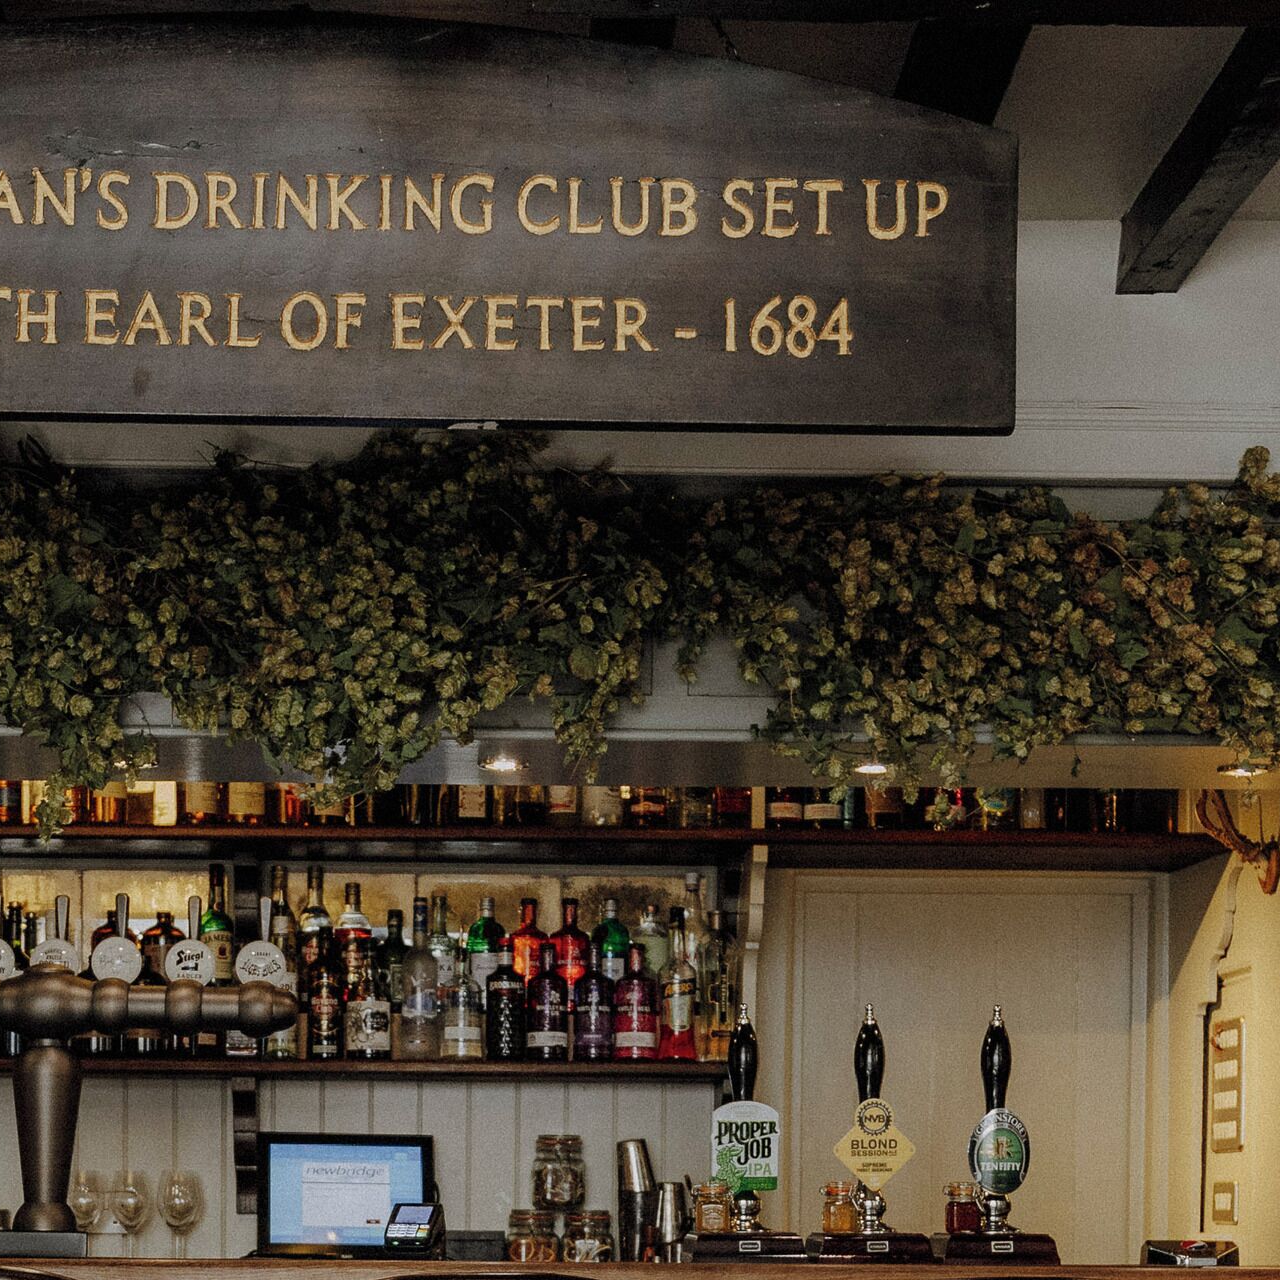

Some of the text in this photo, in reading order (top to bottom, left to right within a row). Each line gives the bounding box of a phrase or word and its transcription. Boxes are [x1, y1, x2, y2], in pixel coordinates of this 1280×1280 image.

[151, 171, 496, 236] DRINKING
[516, 173, 699, 238] CLUB
[720, 175, 845, 239] SET
[863, 178, 950, 240] UP
[82, 288, 262, 348] EARL
[279, 290, 368, 352] OF
[389, 291, 658, 353] EXETER
[723, 292, 855, 360] 1684
[715, 1121, 778, 1146] PROPER
[974, 1113, 1026, 1138] GNSTORE
[737, 1137, 771, 1165] JOB
[851, 1139, 897, 1150] BLOND
[305, 1165, 386, 1178] newbridge
[748, 1163, 772, 1175] IPA
